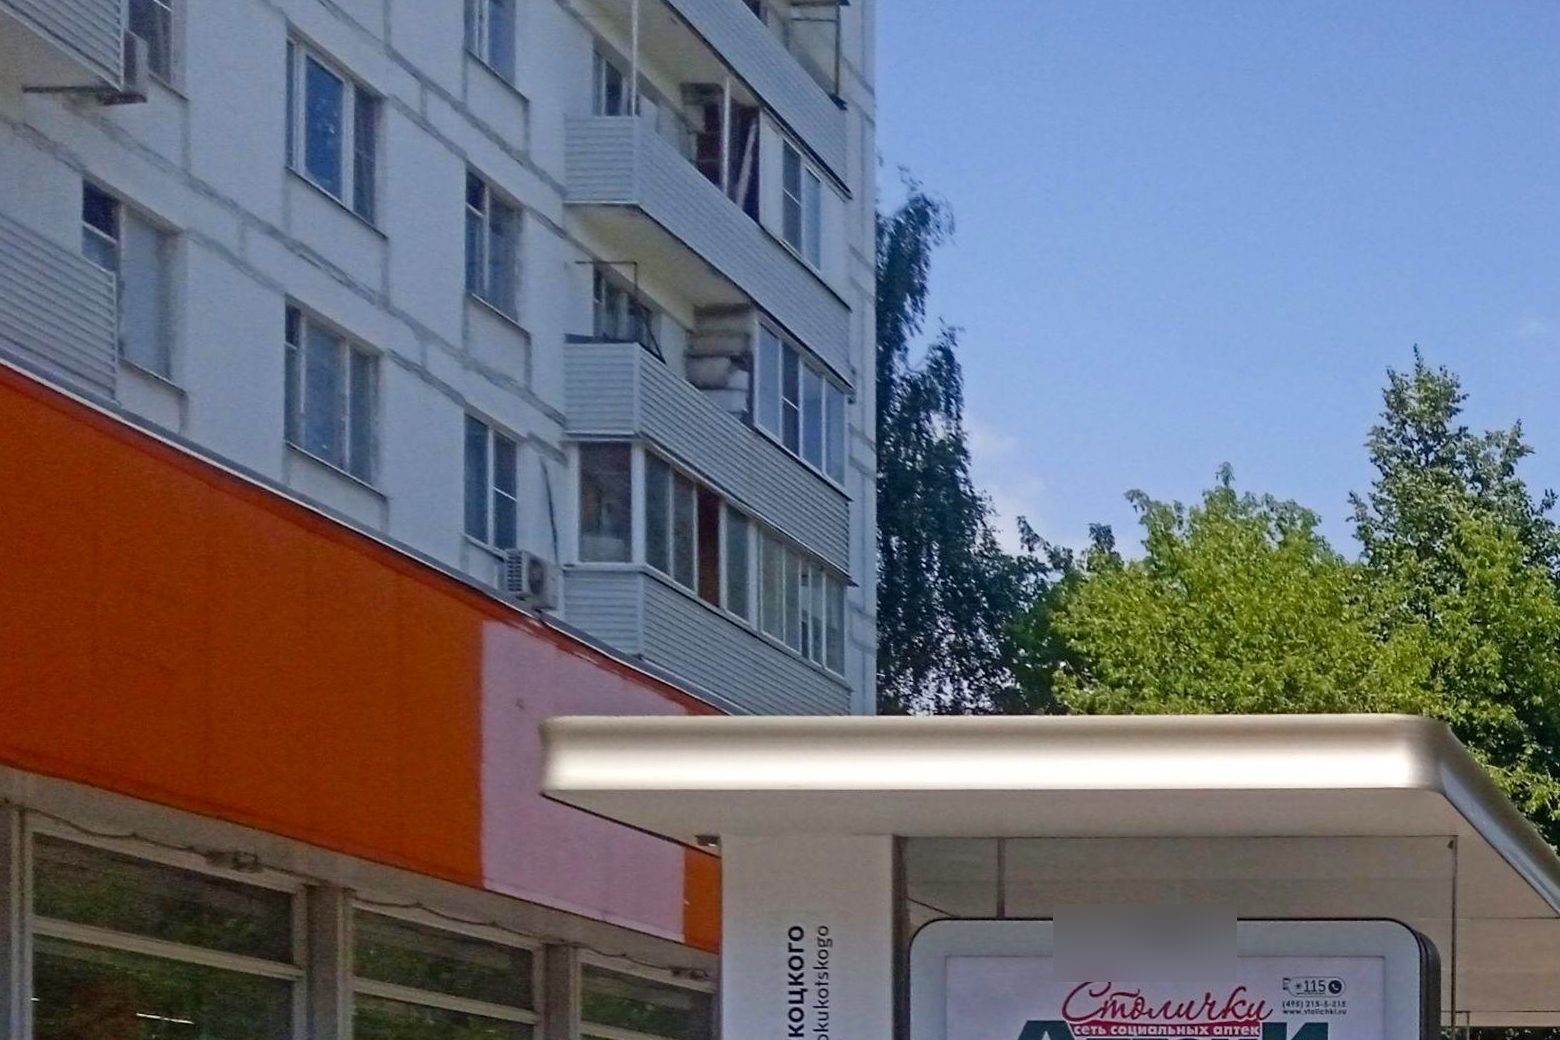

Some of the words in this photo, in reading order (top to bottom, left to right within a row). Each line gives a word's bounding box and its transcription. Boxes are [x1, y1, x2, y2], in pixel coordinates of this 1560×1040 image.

[1061, 982, 1274, 1022] Столички
[1074, 1024, 1107, 1036] сеть
[1110, 1024, 1209, 1036] социальных
[1213, 1024, 1260, 1036] аптек
